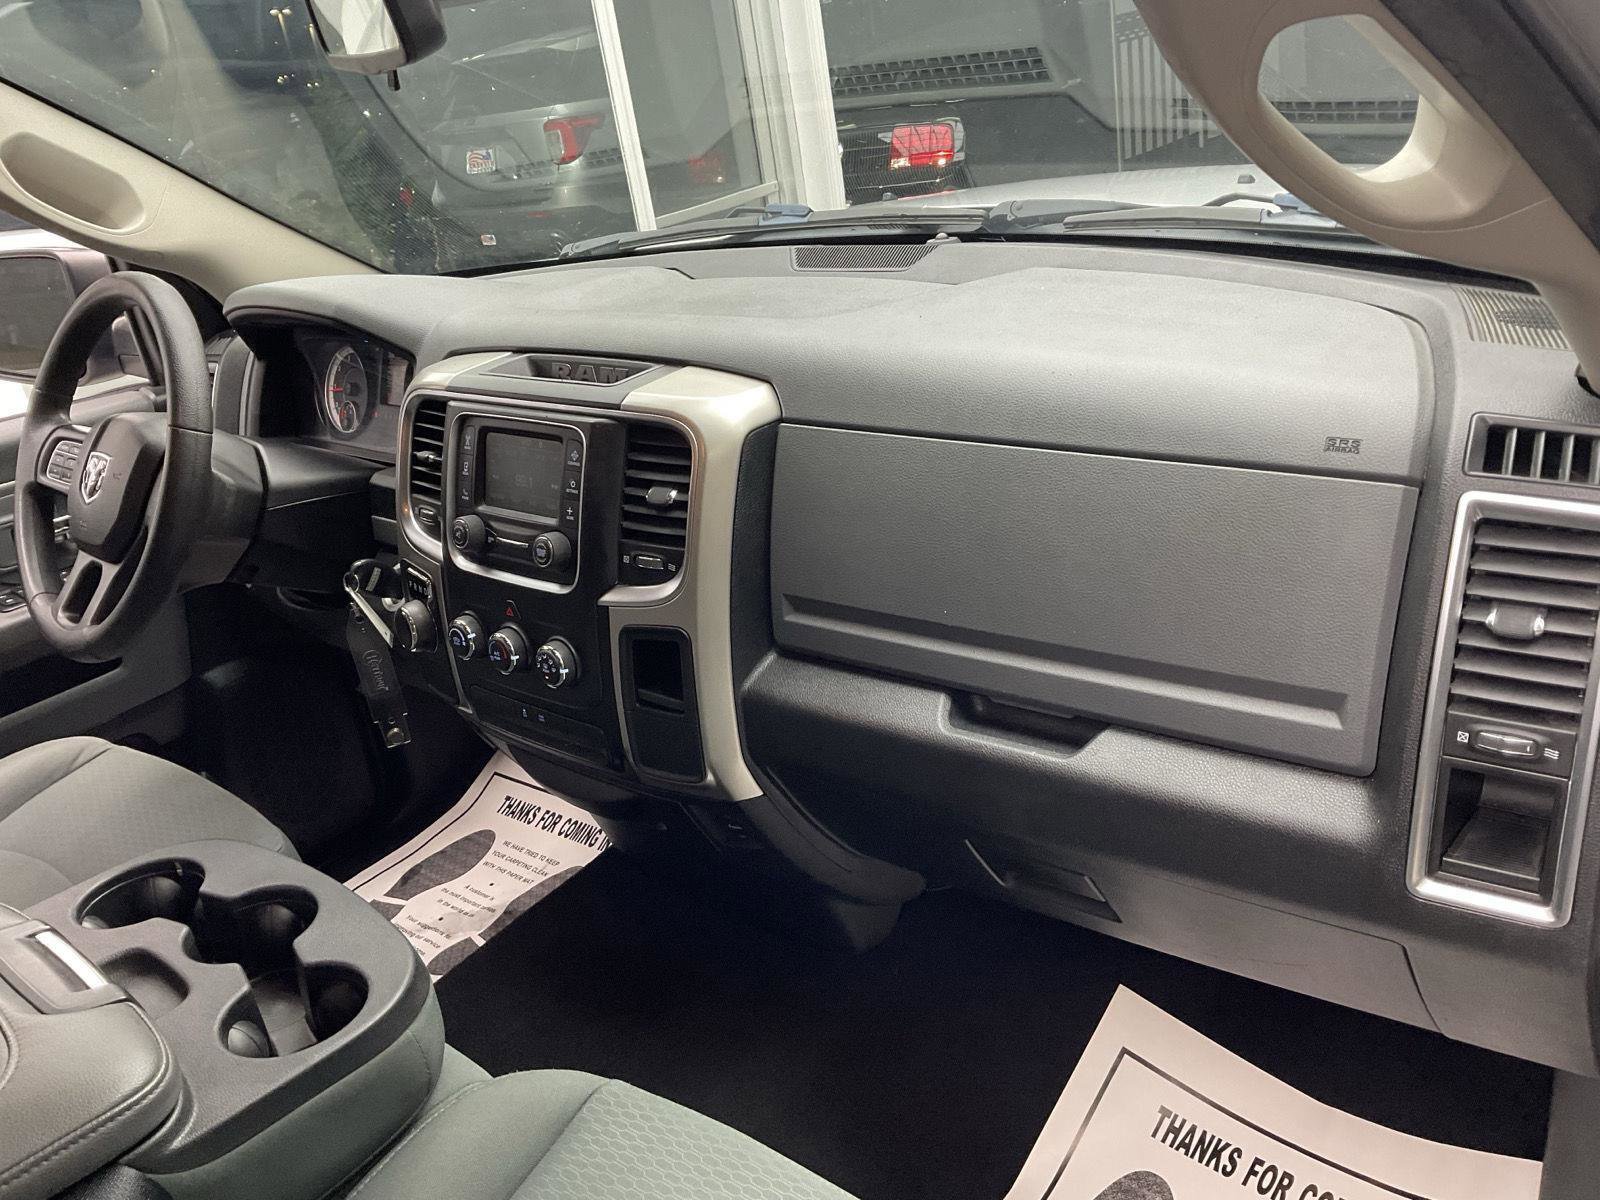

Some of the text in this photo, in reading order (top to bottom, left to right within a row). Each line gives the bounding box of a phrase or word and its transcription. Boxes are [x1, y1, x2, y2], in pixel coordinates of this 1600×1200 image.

[552, 362, 629, 384] RAM
[497, 795, 541, 825] THANKS
[535, 810, 563, 833] FOR
[557, 818, 603, 848] COMING
[510, 843, 525, 852] HAVE
[523, 848, 539, 859] TRIED
[1150, 1104, 1295, 1200] THANKS FOR
